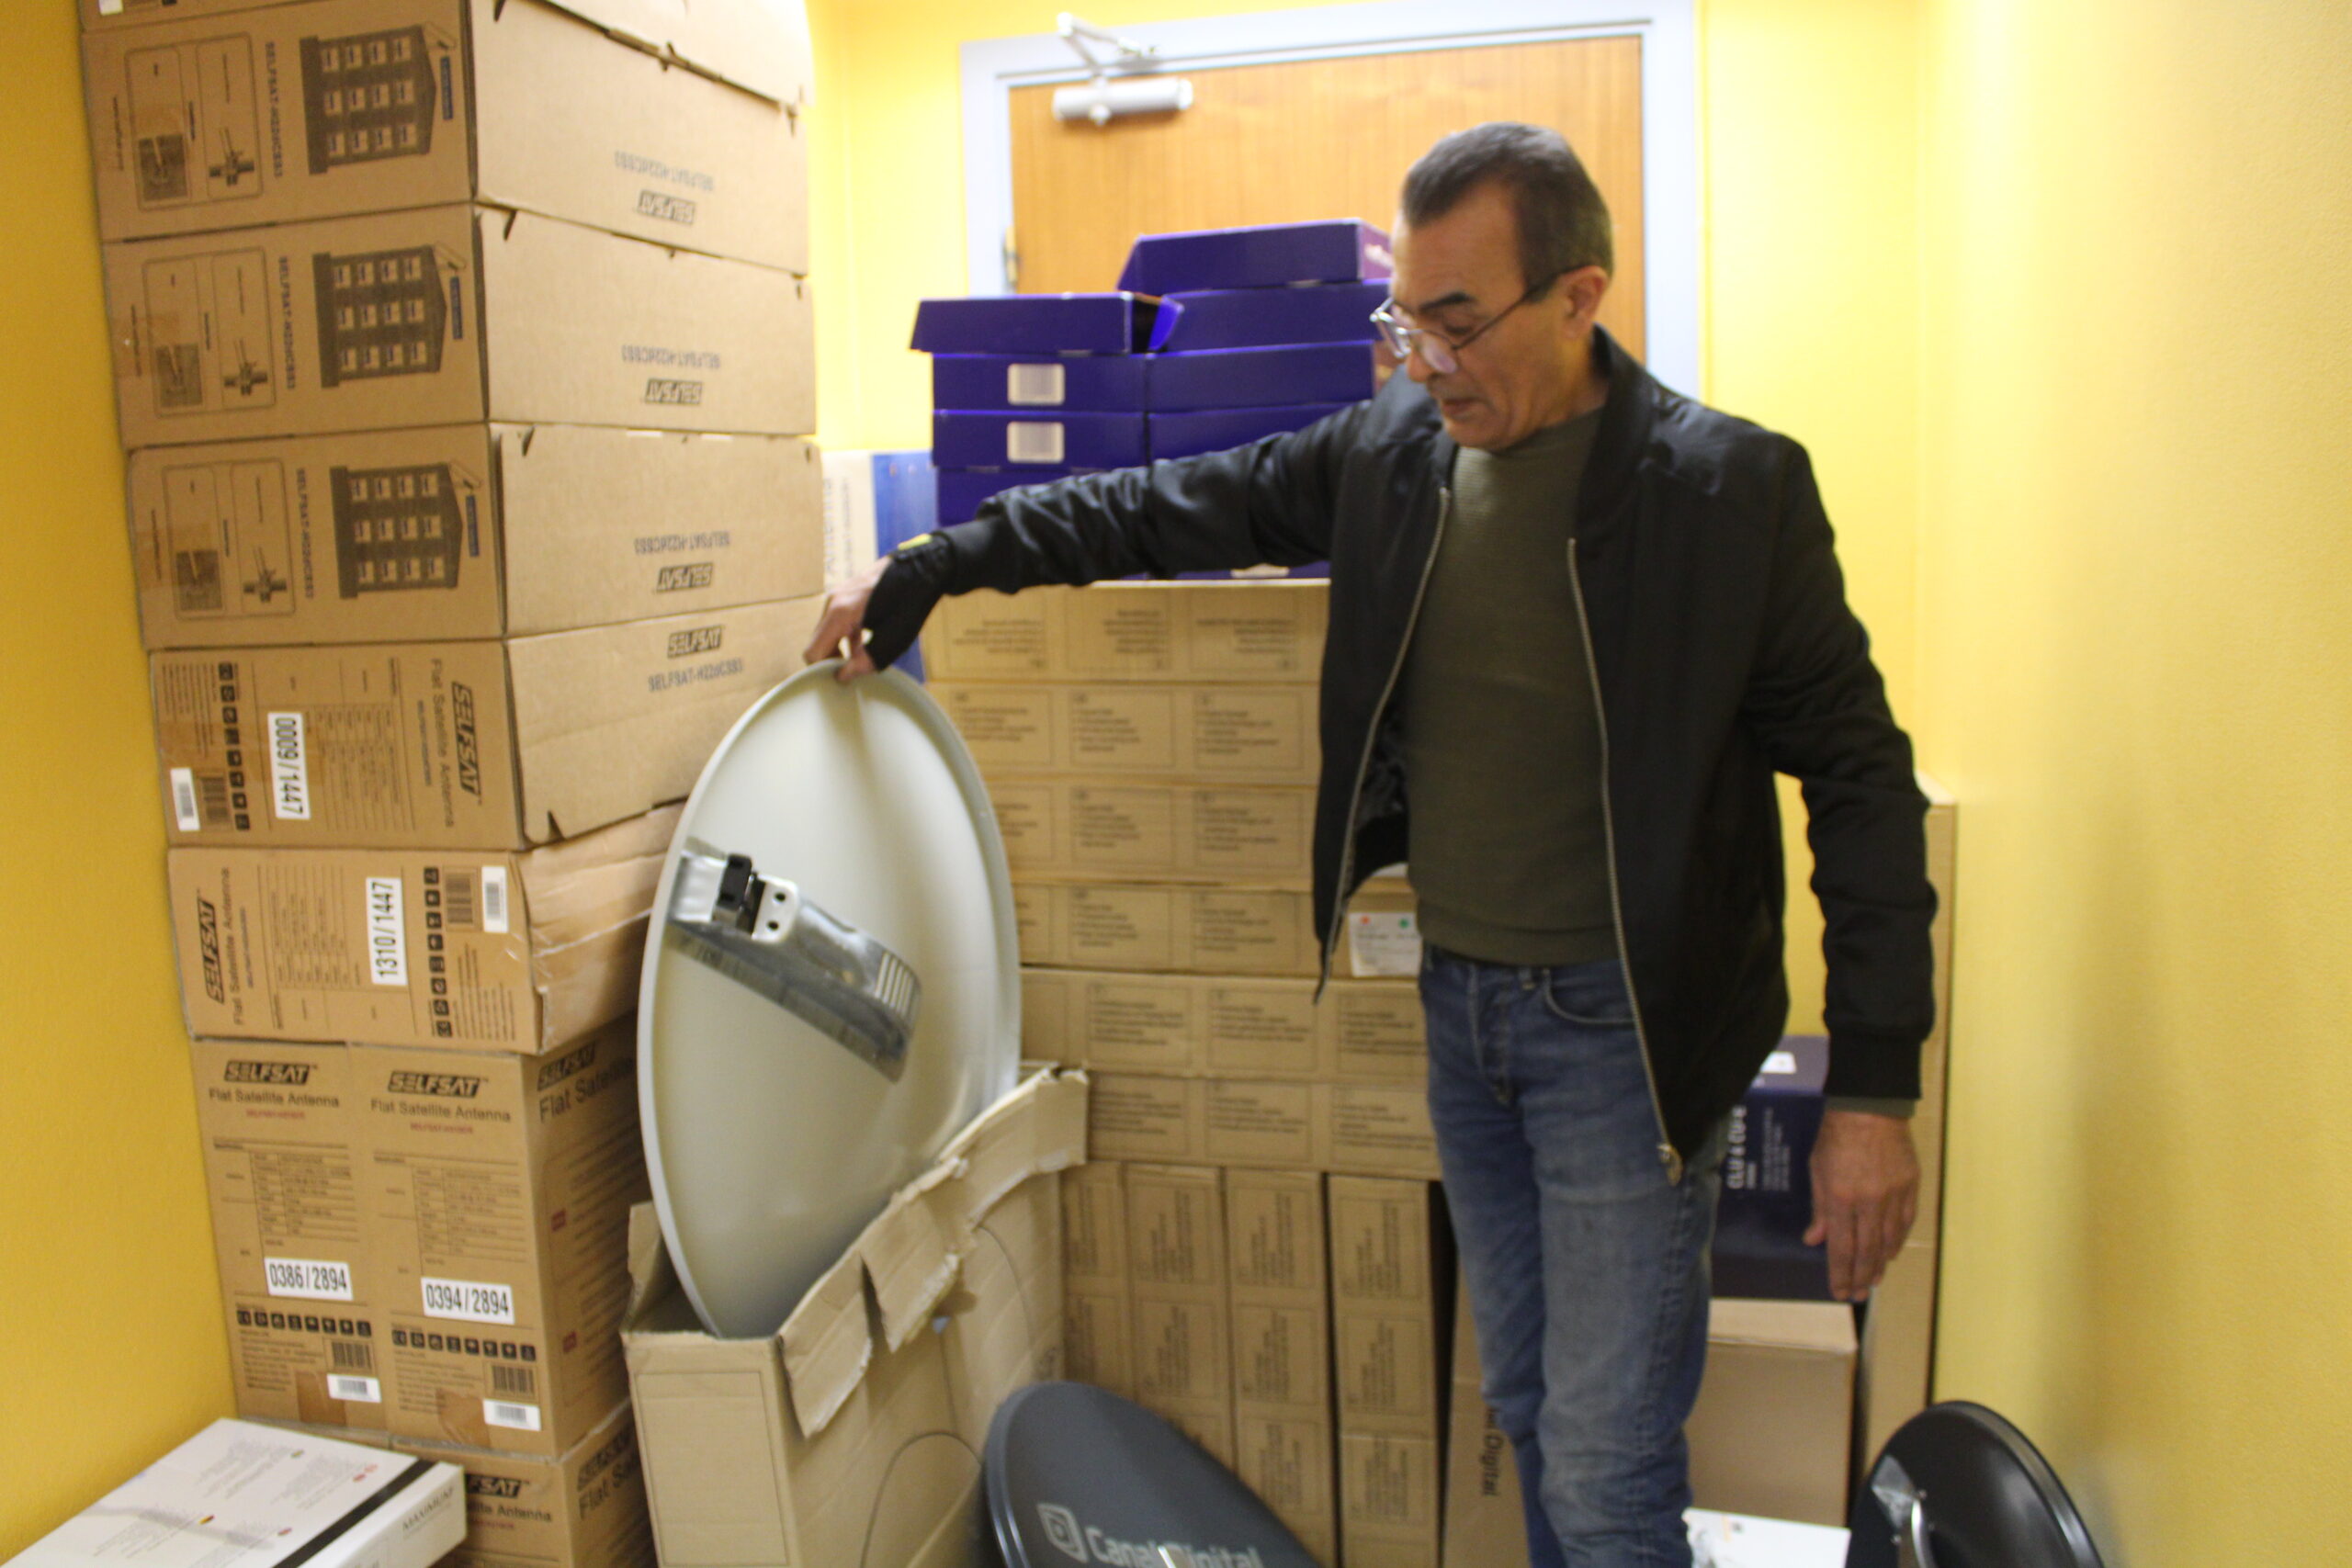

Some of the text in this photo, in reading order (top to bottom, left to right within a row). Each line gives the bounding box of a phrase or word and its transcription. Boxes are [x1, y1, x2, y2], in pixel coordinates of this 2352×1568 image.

[638, 189, 697, 225] SELFSAT
[645, 377, 703, 405] SELFSAT
[656, 561, 714, 593] SELFSAT
[667, 624, 723, 660] SELFSAT
[451, 681, 481, 797] SELFSAT
[275, 716, 305, 817] 0009/1447
[370, 880, 400, 978] 1310/1447
[197, 898, 225, 1005] SELFSAT
[224, 1060, 311, 1085] SELFSAT
[388, 1070, 481, 1098] SELFSAT
[209, 1088, 339, 1108] Flat Satellite Antenna
[370, 1098, 512, 1122] Flat Satellite Antenna
[268, 1263, 348, 1290] 0386/2894
[425, 1286, 509, 1315] 0394/2894
[1480, 1435, 1504, 1496] Digital
[496, 1504, 551, 1522] Antenna
